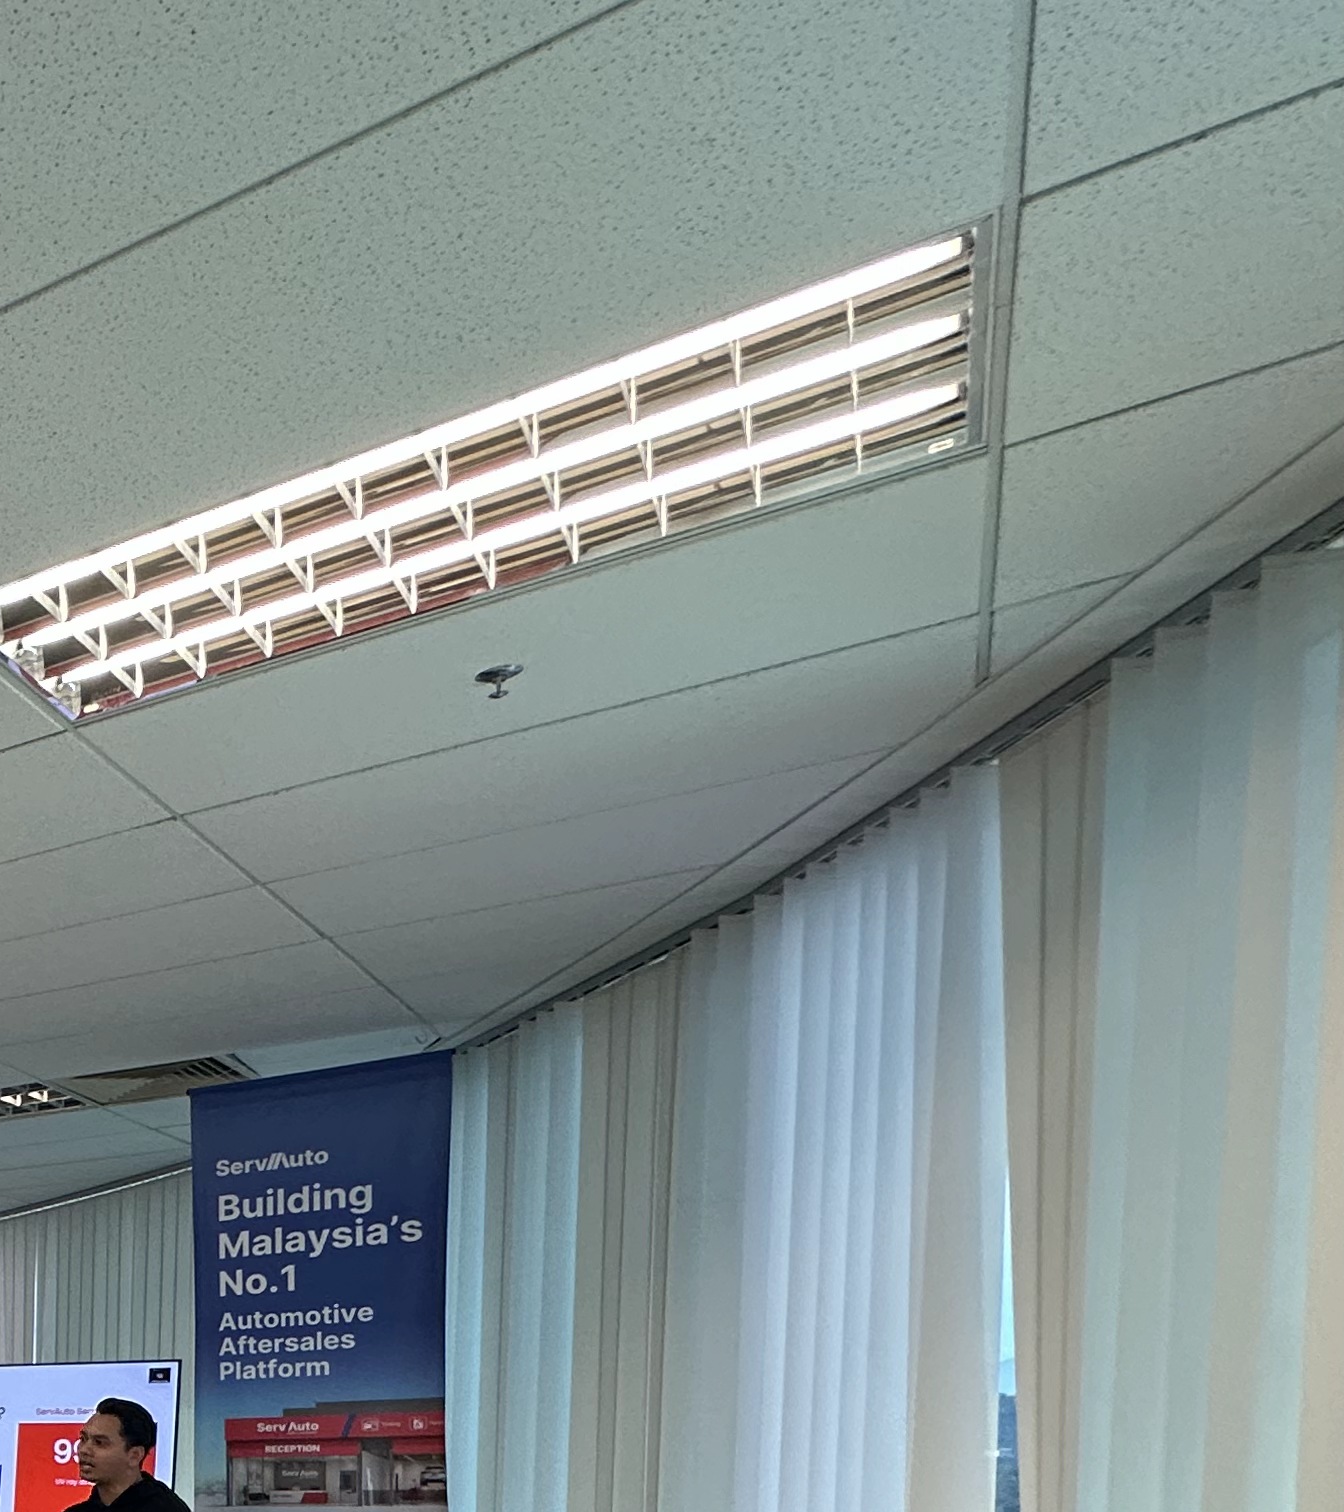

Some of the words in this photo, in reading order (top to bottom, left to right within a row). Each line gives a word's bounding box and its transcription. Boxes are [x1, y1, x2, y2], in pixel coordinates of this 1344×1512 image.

[218, 1183, 373, 1222] Building
[218, 1215, 423, 1260] Malaysia's
[219, 1264, 296, 1297] No.1
[219, 1303, 374, 1331] Automotive
[219, 1331, 356, 1356] Aftersales
[220, 1359, 330, 1381] Platform
[265, 1444, 320, 1453] RECEPTION
